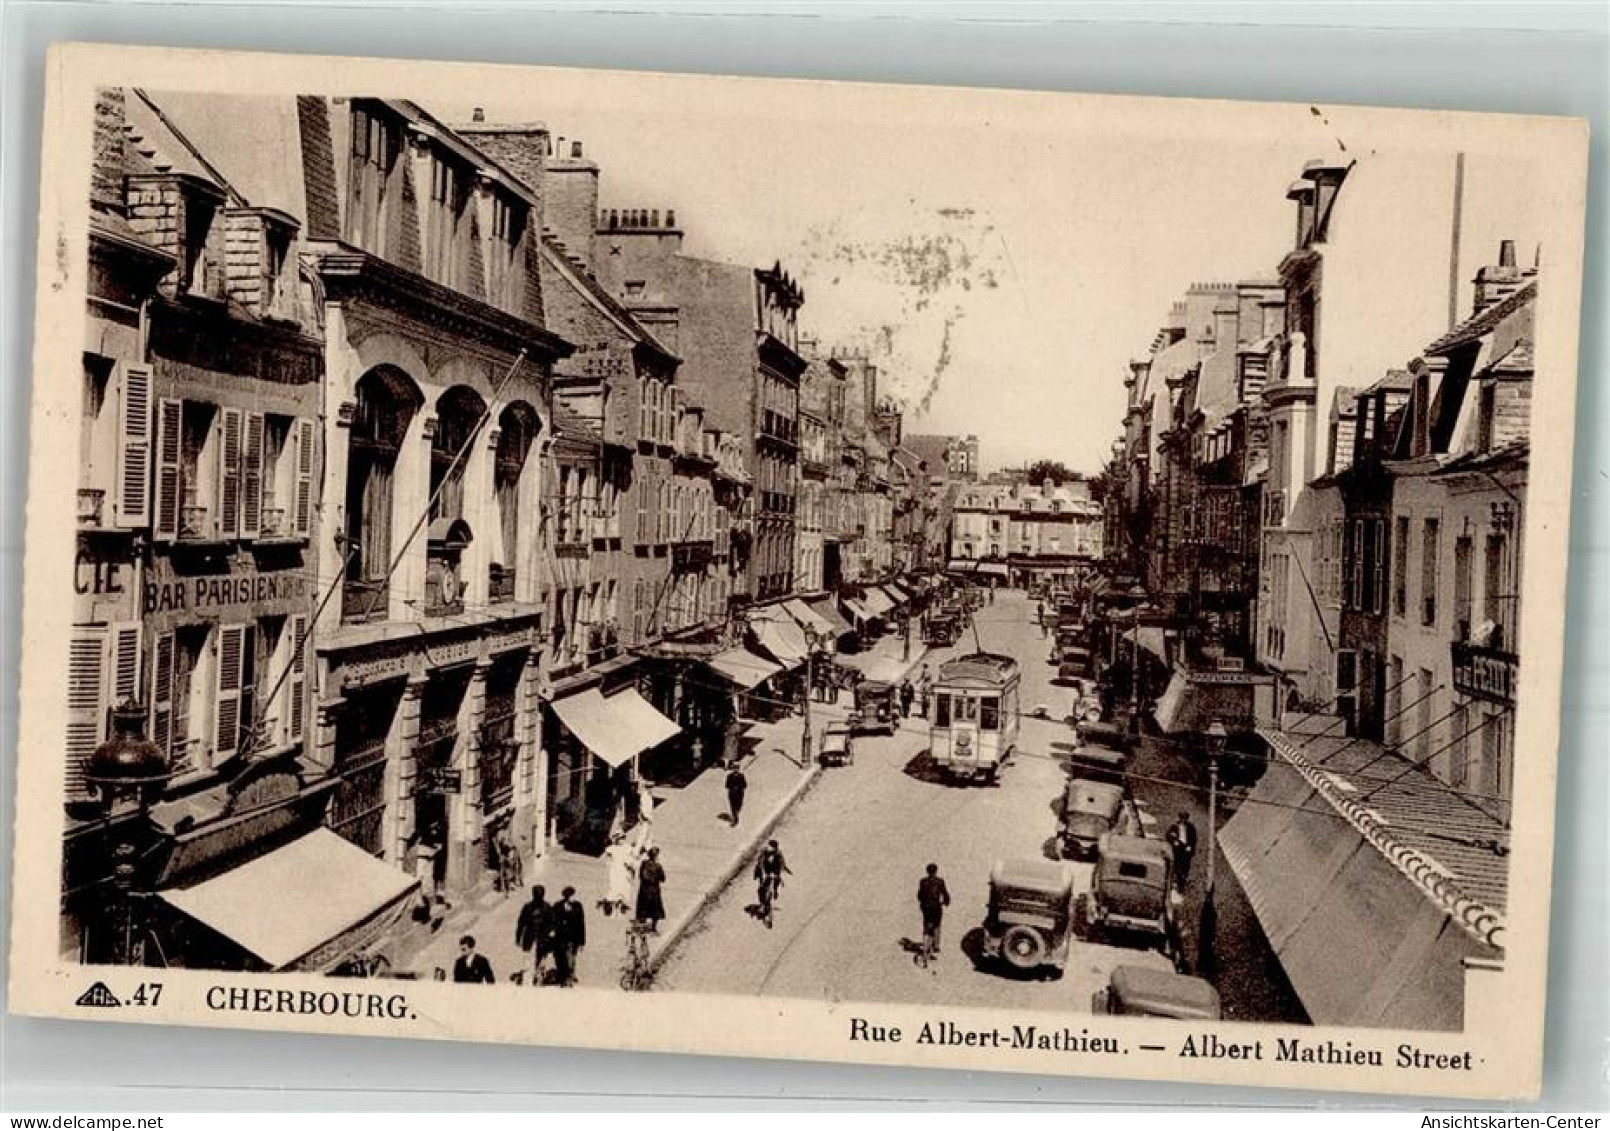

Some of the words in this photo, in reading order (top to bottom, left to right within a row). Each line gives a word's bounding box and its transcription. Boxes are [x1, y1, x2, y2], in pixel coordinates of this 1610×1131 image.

[145, 581, 186, 612] BAR
[206, 985, 417, 1020] CHERBOURG.
[849, 1018, 902, 1043] Rue
[917, 1021, 1129, 1055] Albert-Mathieu.
[1178, 1034, 1263, 1060] Albert
[1275, 1037, 1383, 1066] Mathieu
[1396, 1044, 1472, 1070] Street
